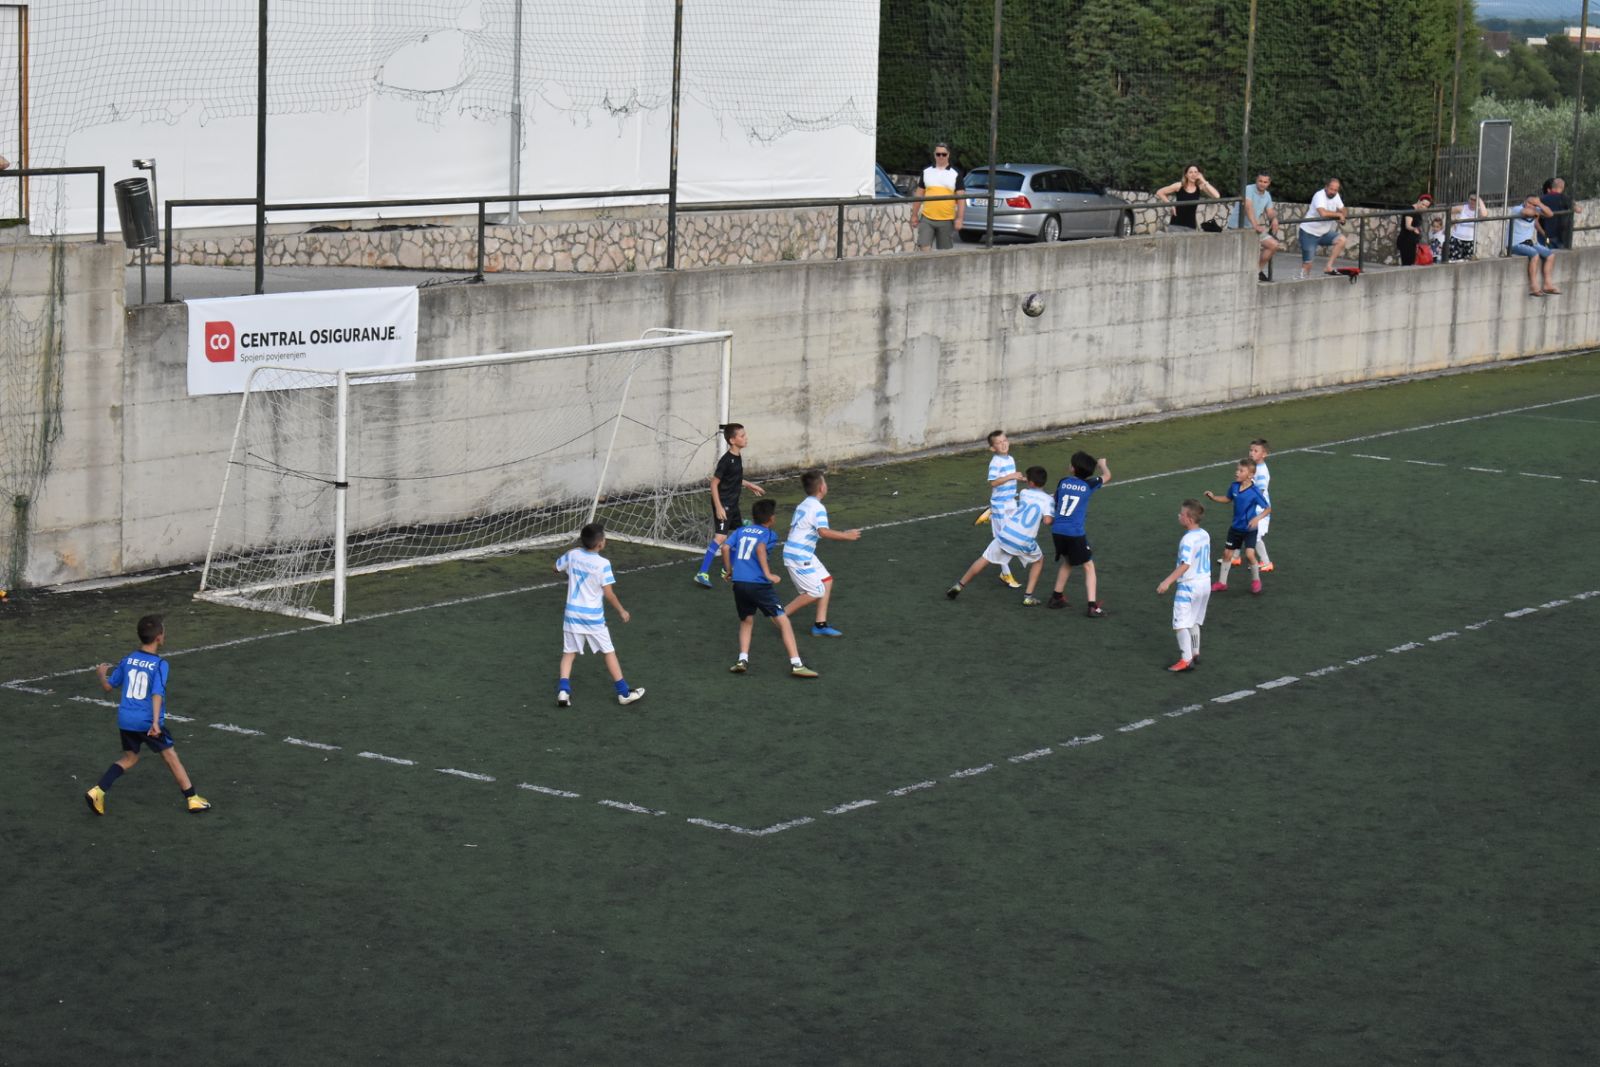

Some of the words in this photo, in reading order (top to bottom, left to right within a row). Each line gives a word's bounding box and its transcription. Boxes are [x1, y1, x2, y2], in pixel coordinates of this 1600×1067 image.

[240, 331, 306, 348] CENTRAL
[309, 326, 396, 344] OSIGURANJE
[240, 353, 266, 363] Spojeni
[266, 351, 307, 362] povjerenjem
[1010, 502, 1041, 528] 20
[1059, 495, 1080, 516] 17
[719, 523, 725, 533] 1
[738, 537, 757, 559] 17
[1195, 544, 1210, 574] 10
[572, 568, 590, 599] 7
[127, 658, 156, 670] BEGIĆ
[126, 669, 147, 700] 10
